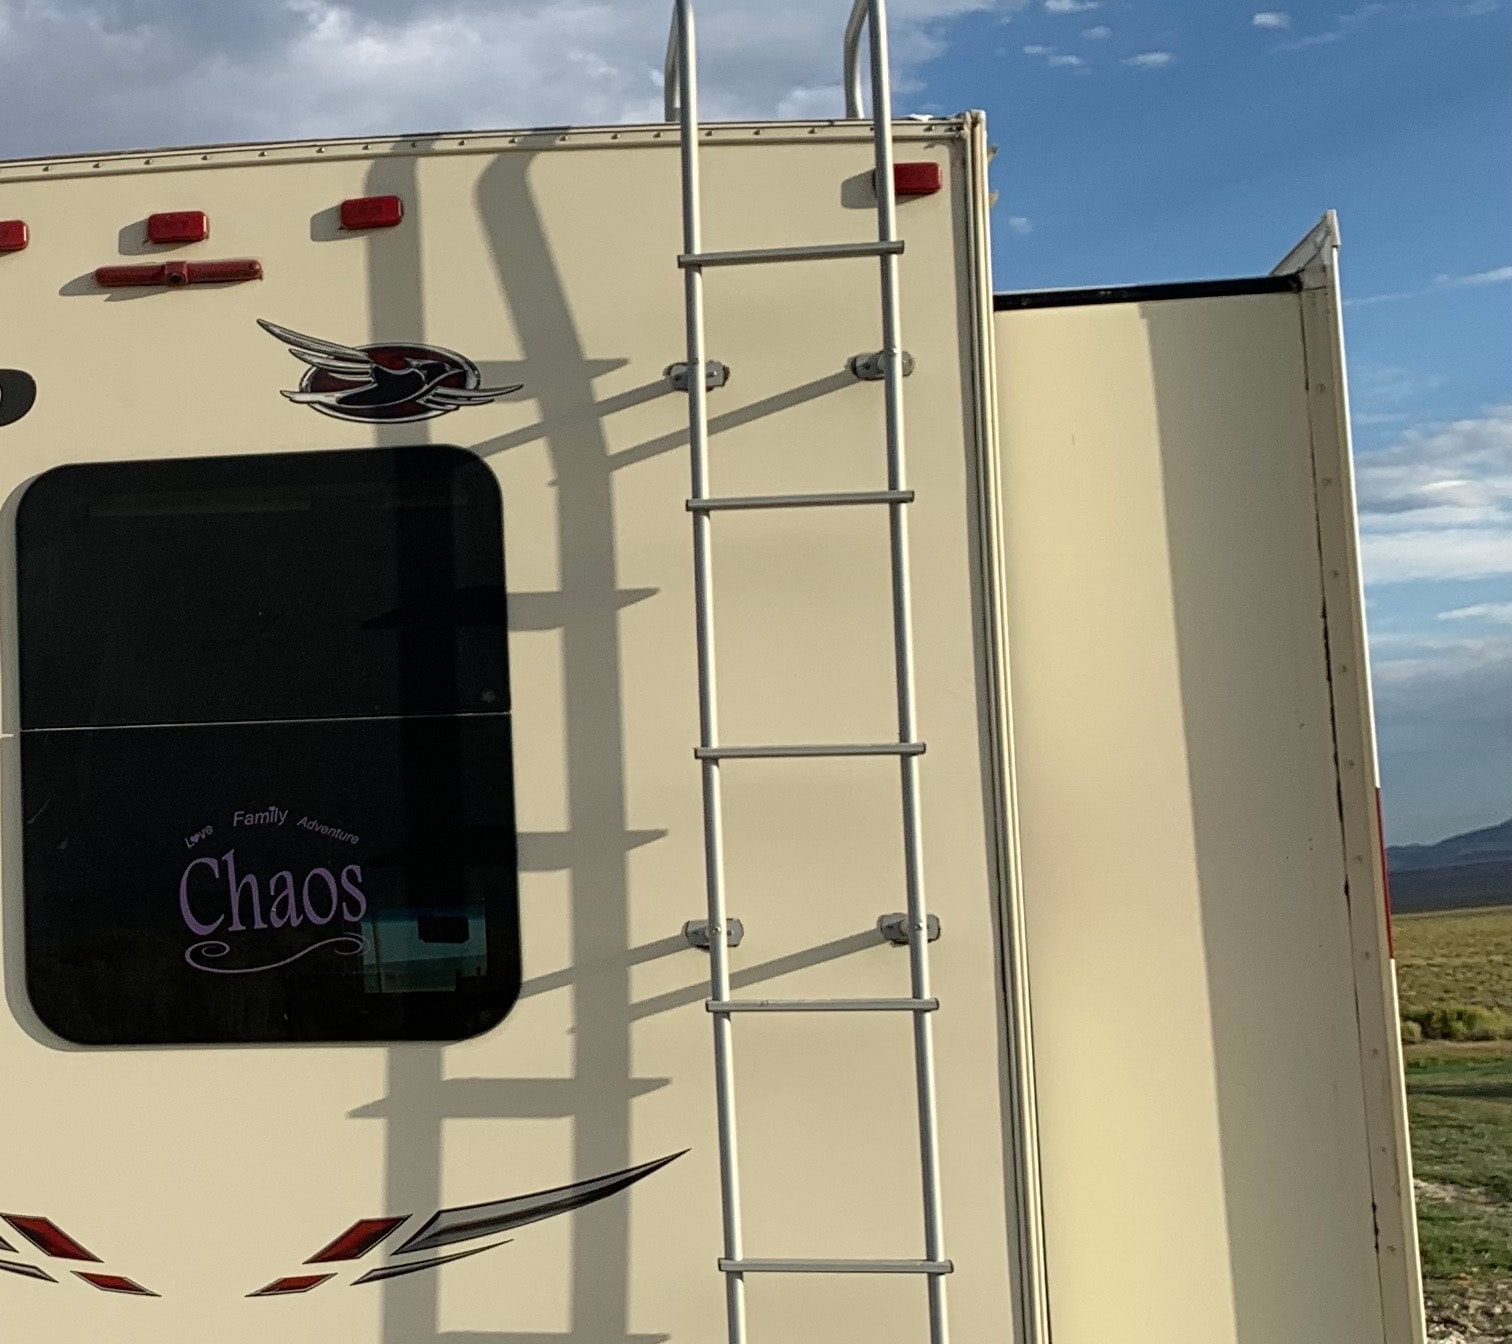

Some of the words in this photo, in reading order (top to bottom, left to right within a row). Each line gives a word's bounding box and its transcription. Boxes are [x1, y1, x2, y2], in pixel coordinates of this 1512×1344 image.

[232, 806, 289, 827] Family
[296, 816, 361, 845] Adventure
[179, 849, 367, 936] Chaos
